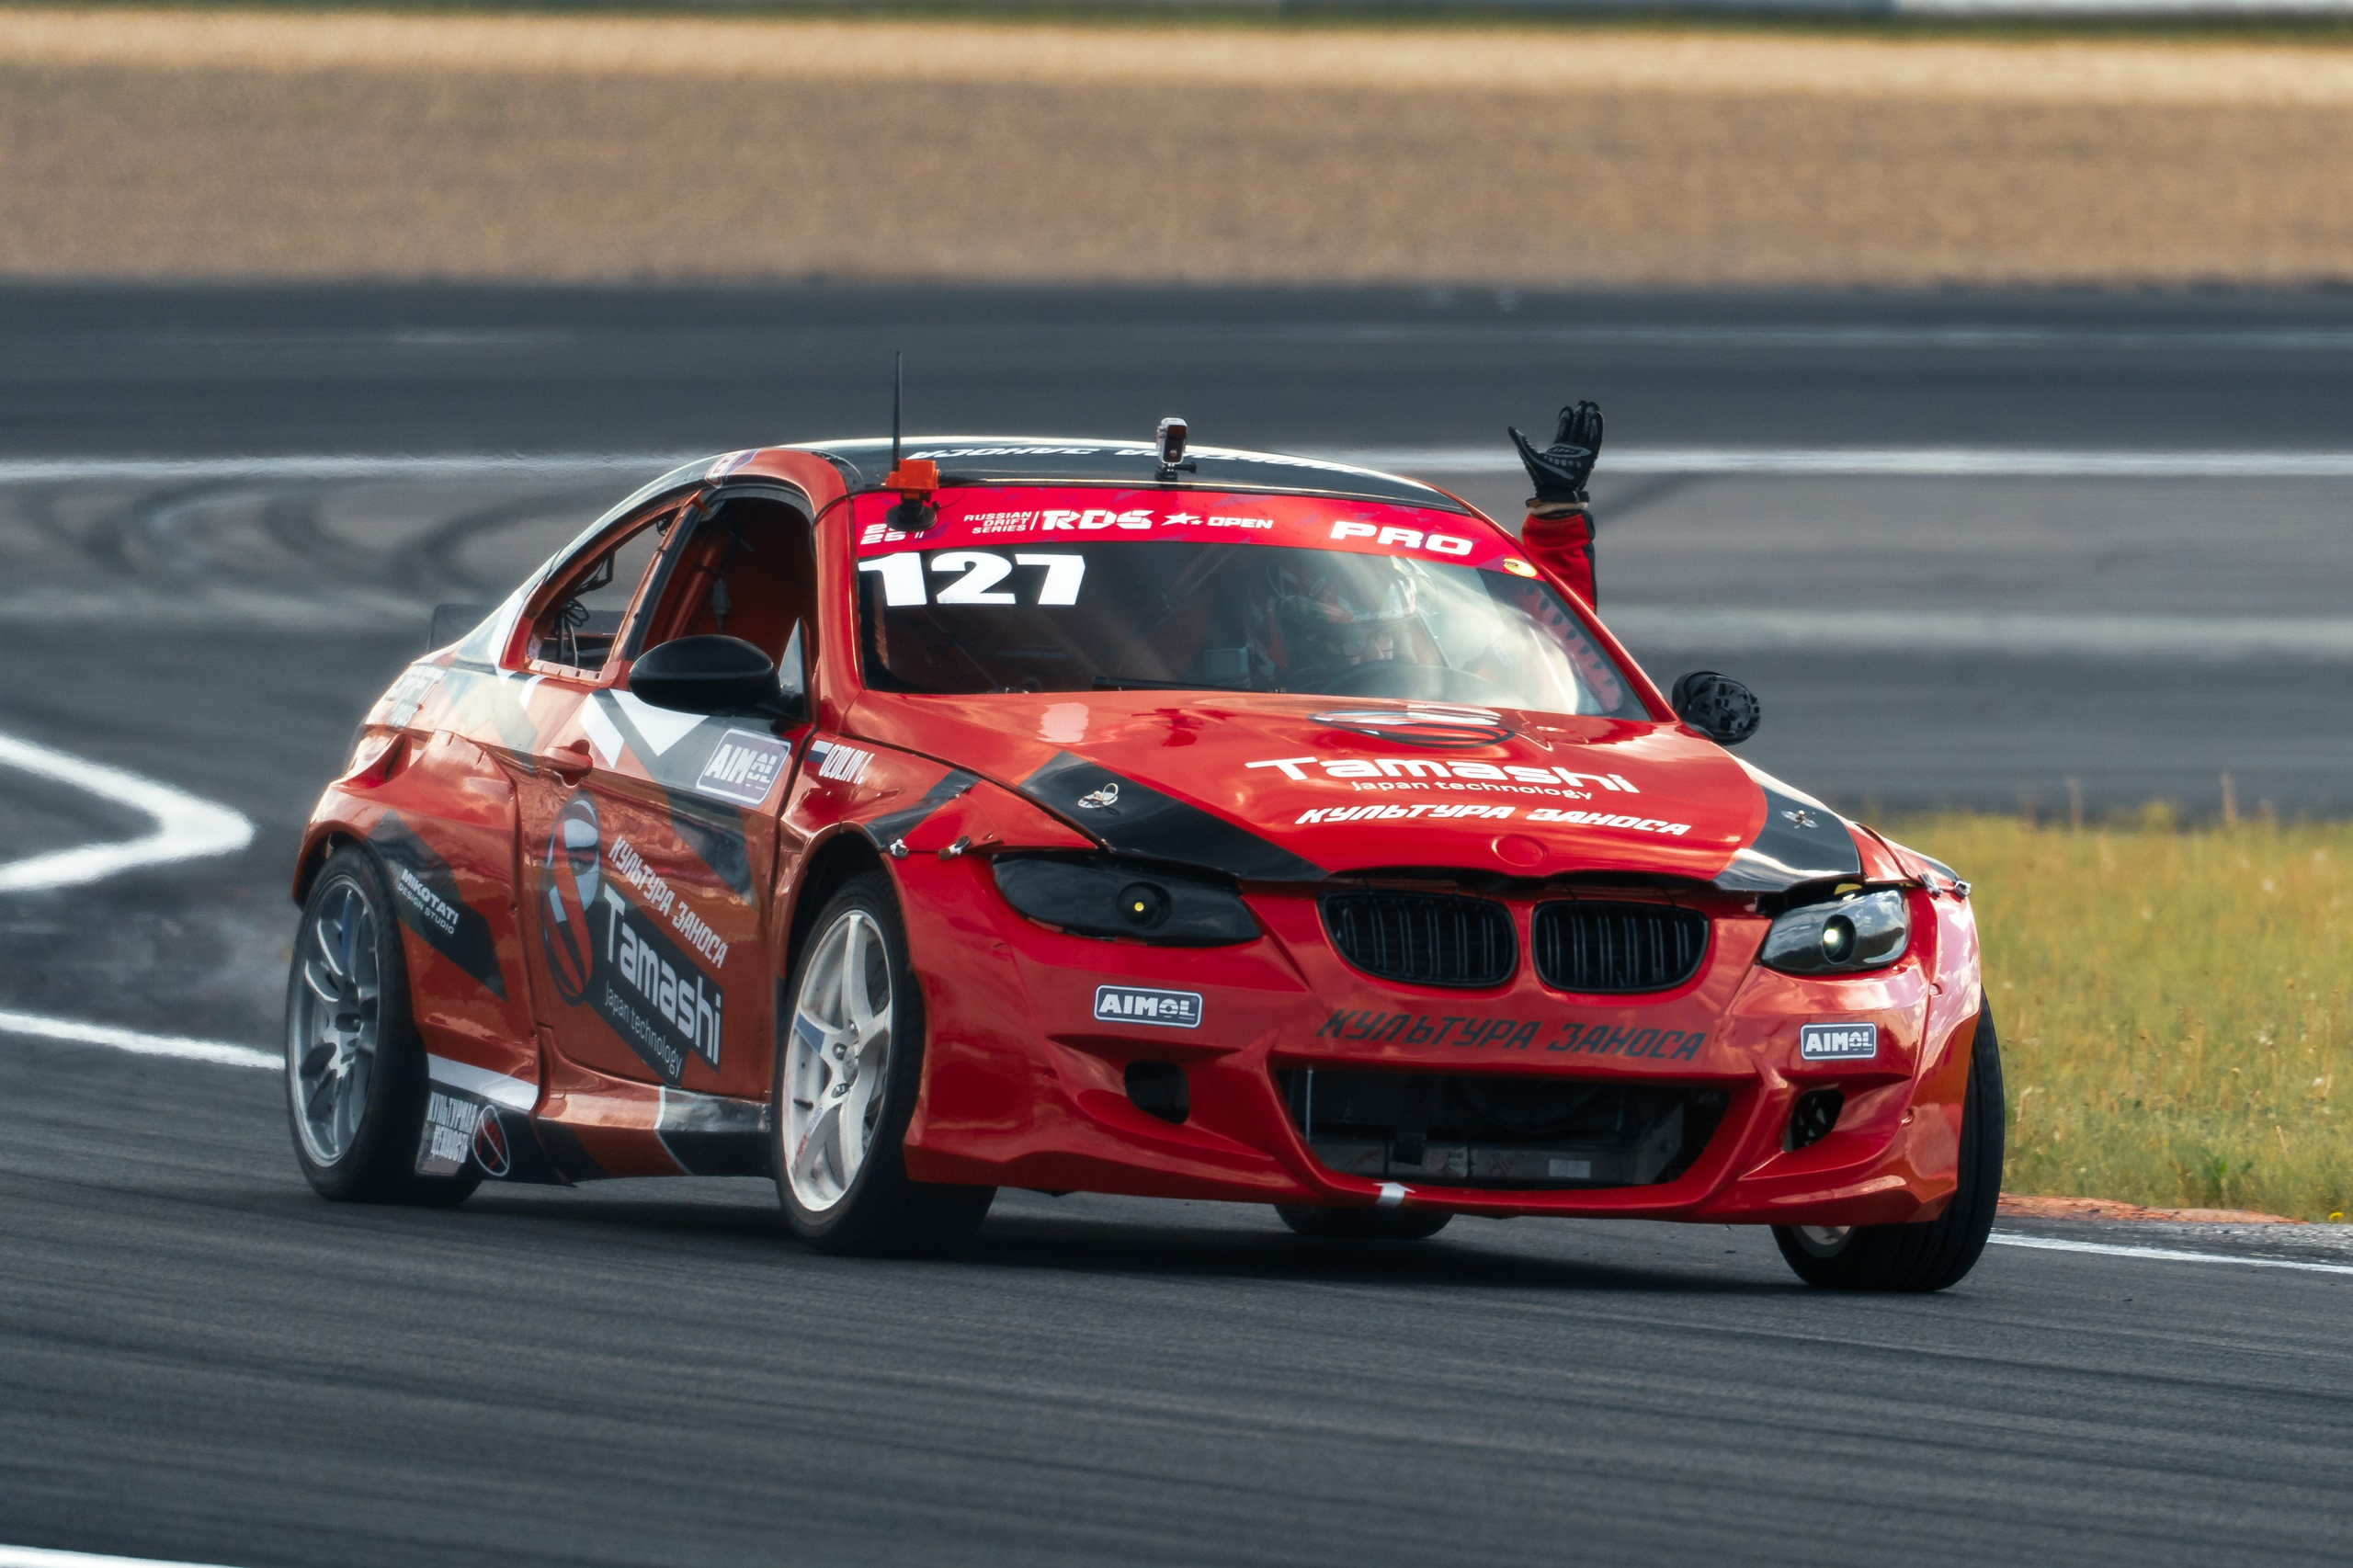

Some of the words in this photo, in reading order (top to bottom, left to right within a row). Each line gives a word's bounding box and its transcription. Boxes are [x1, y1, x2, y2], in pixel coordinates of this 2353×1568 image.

[963, 511, 1034, 522] RUSSIAN
[972, 524, 1027, 535] SERIES
[983, 517, 1031, 528] DRIFT
[1041, 509, 1154, 530] RDS
[1207, 516, 1274, 529] OPEN
[859, 531, 907, 545] 25
[1330, 520, 1473, 556] PRO
[858, 551, 1086, 607] 127
[704, 744, 779, 790] AIMOL
[819, 744, 869, 784] OZOLIN
[1245, 756, 1640, 793] Tamashi
[1353, 778, 1430, 791] Japan
[1434, 780, 1593, 801] technology
[1294, 803, 1518, 825] КУЛЬТУРА
[1526, 808, 1692, 835] ЗАНОСА
[397, 882, 425, 910] DESIGN
[424, 907, 455, 935] STUDIO
[401, 868, 460, 926] MIKOTATI
[608, 835, 676, 916] КУЛЬТУРА
[672, 901, 729, 970] ЗАНОСА
[604, 882, 722, 1066] Tamashi
[1098, 994, 1196, 1020] AIMOL
[605, 980, 631, 1025] Japan
[631, 1009, 683, 1080] technology
[1315, 1009, 1543, 1050] КУЛЬТУРА
[1546, 1022, 1708, 1062] ЗАНОСА
[1804, 1031, 1873, 1052] AIMOL
